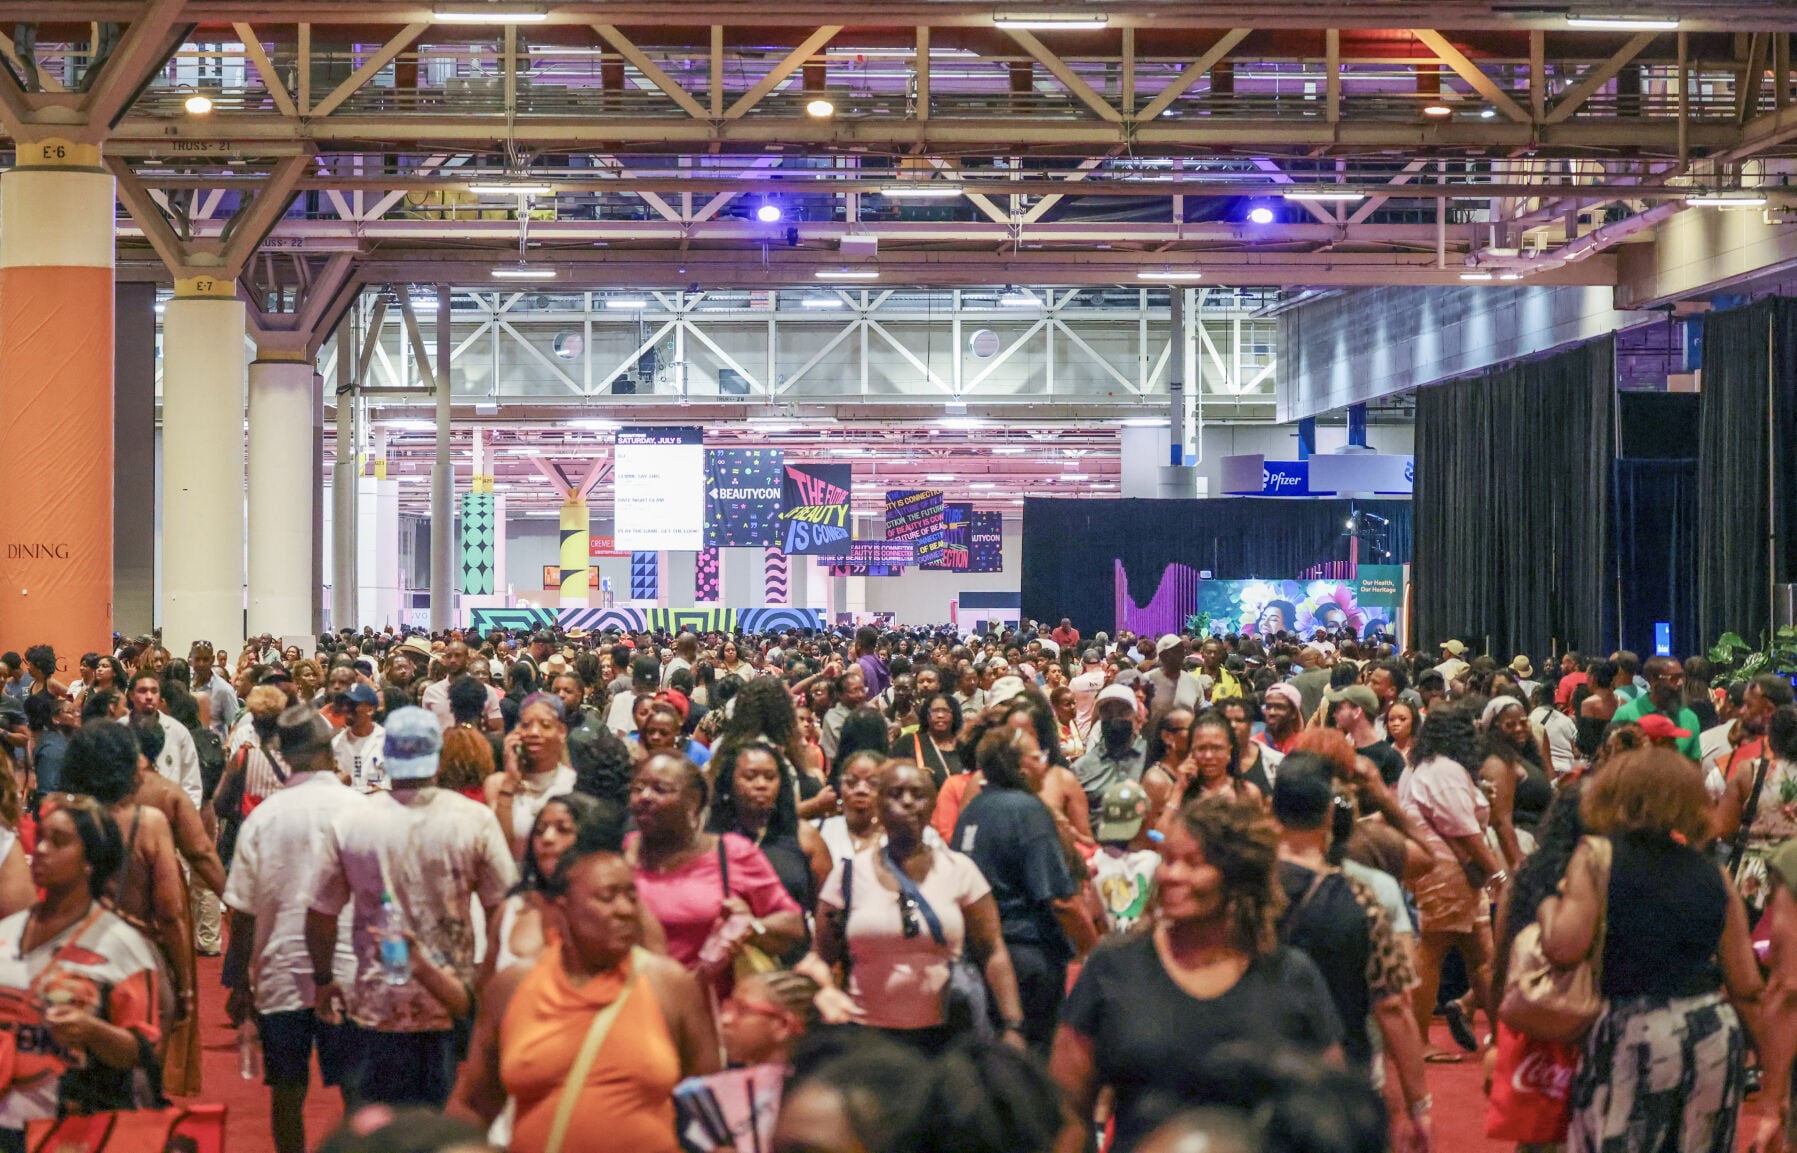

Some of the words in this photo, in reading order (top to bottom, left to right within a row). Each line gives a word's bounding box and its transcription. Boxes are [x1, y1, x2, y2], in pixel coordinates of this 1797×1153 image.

[219, 141, 230, 150] 21
[291, 239, 302, 247] 22
[617, 437, 657, 445] SATURDAY,
[784, 464, 826, 506] THE
[1270, 472, 1301, 491] Pfizer
[720, 488, 780, 499] BEAUTYCON
[792, 504, 849, 528] BEAUTY
[907, 511, 920, 522] THE
[896, 520, 922, 534] BEAUTY
[784, 520, 810, 554] IS
[8, 543, 69, 559] DINING
